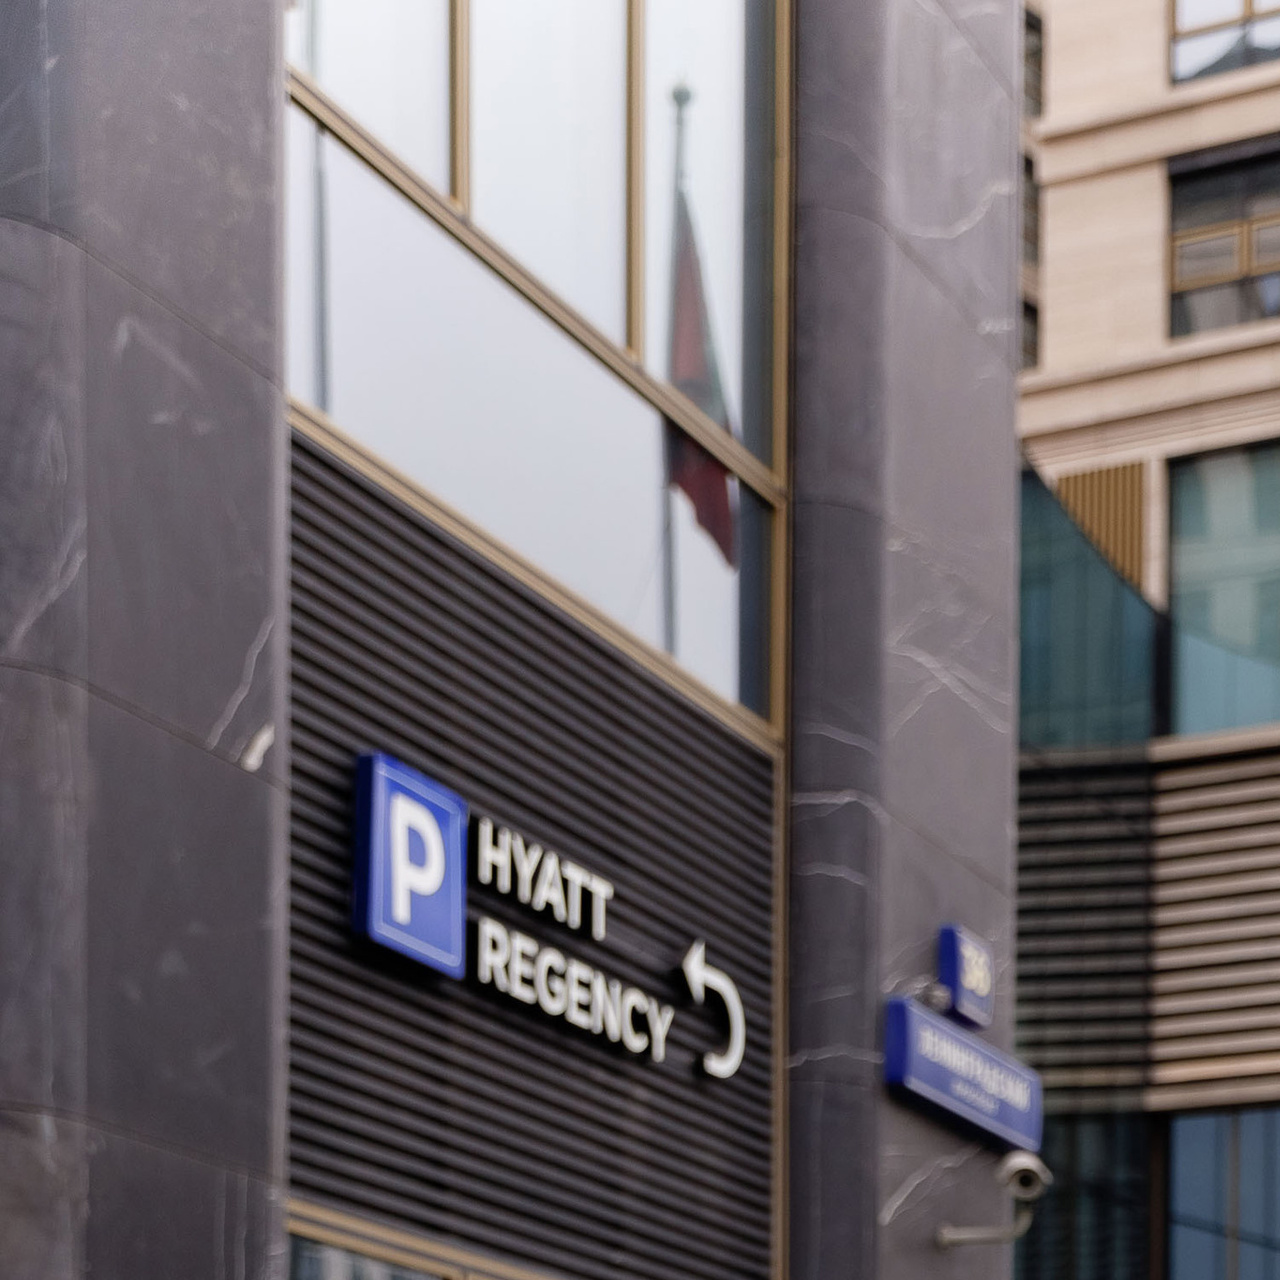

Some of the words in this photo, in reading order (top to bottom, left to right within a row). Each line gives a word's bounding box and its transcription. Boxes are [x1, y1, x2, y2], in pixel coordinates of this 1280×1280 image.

[391, 793, 445, 925] P
[478, 816, 614, 941] HYATT
[478, 917, 675, 1062] REGENCY
